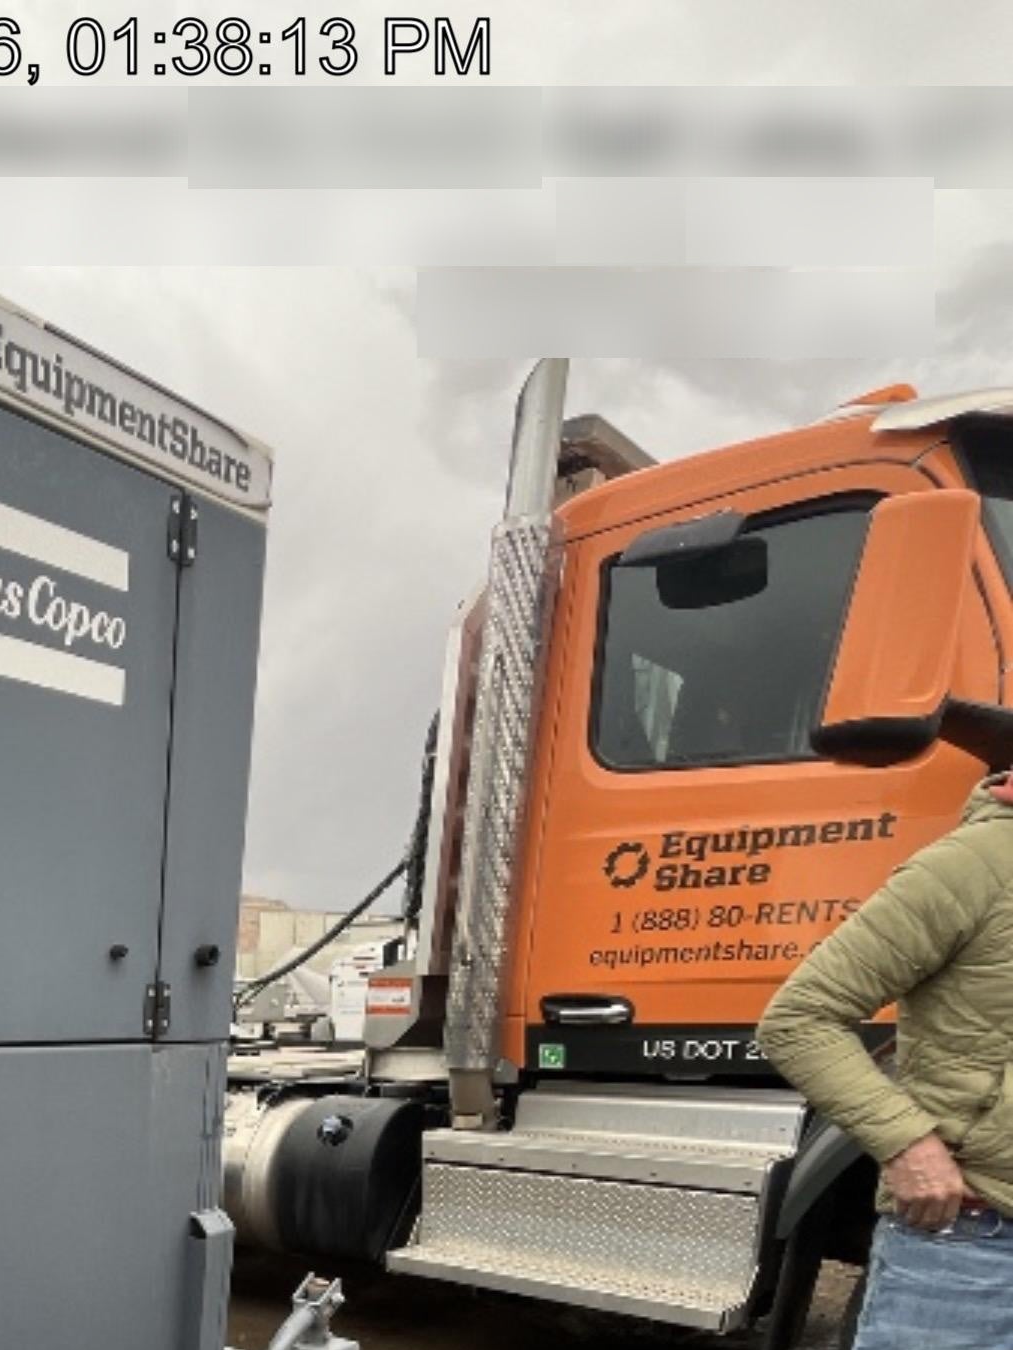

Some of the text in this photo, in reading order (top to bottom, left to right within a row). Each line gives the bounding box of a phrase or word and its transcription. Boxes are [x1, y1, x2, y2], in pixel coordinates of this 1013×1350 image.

[28, 576, 127, 649] Copco
[658, 812, 896, 862] Equipment
[653, 862, 771, 891] Share
[610, 896, 861, 934] 1 (888) 80-RENTS
[643, 1040, 676, 1059] US
[682, 1040, 740, 1060] DOT
